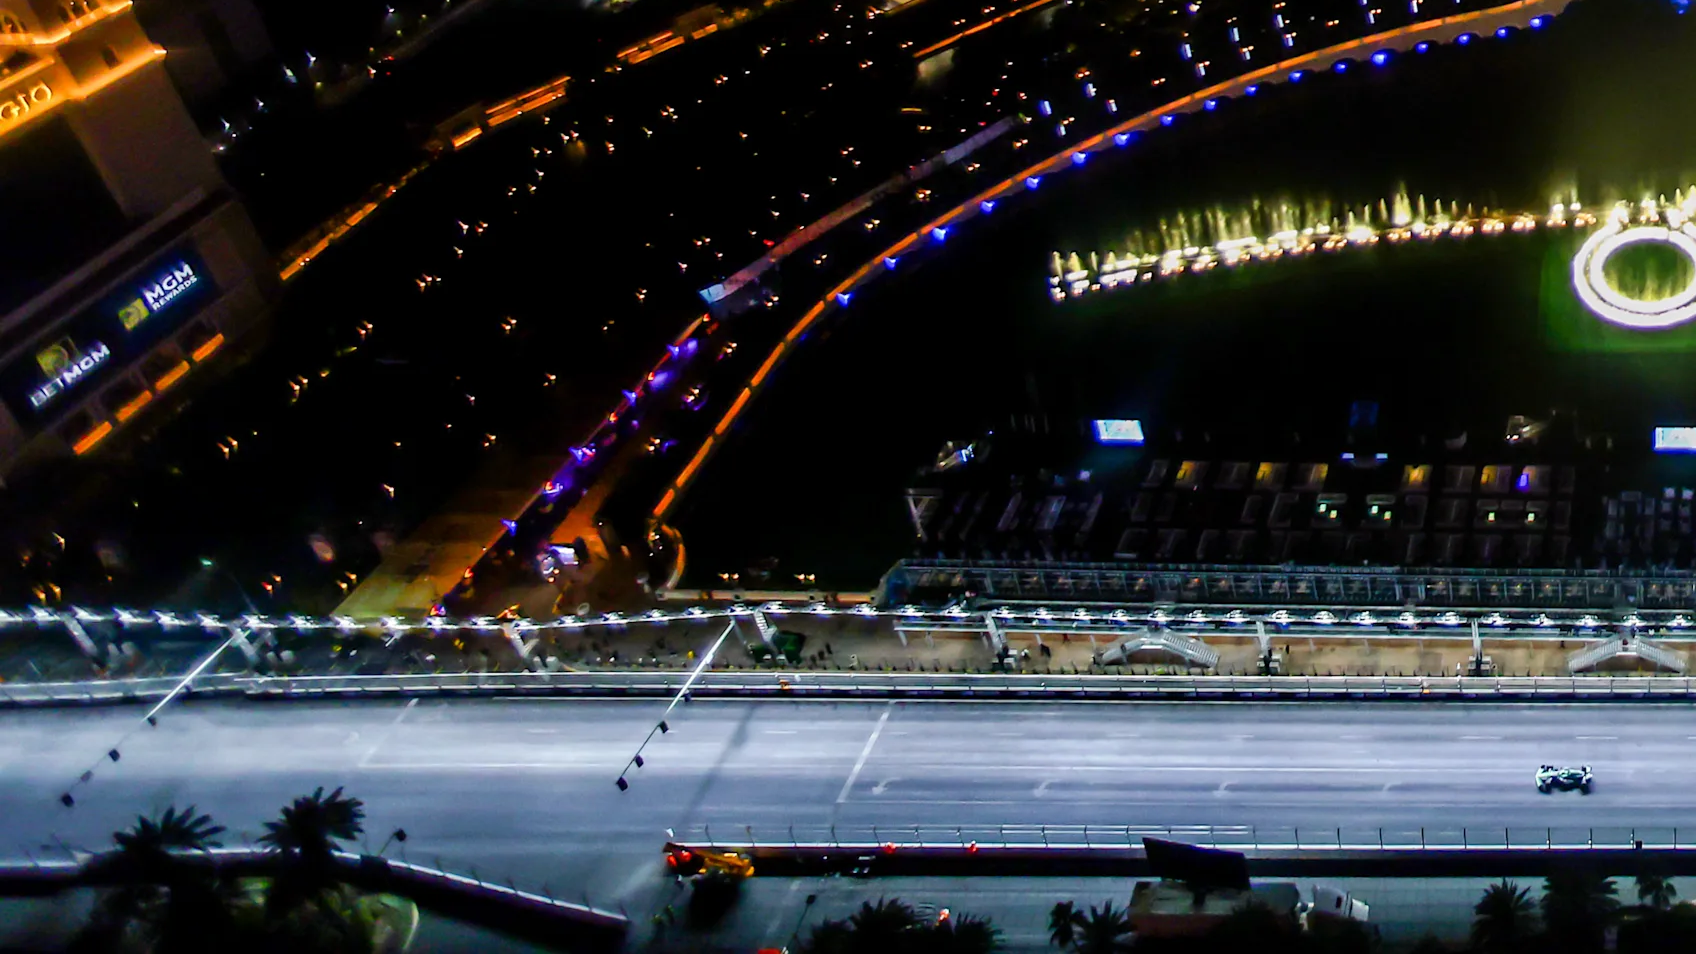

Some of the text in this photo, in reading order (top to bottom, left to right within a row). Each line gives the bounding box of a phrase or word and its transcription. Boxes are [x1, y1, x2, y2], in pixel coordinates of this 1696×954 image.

[143, 263, 194, 305] MGM
[152, 274, 198, 311] REWARDS
[29, 344, 111, 407] BETMGM
